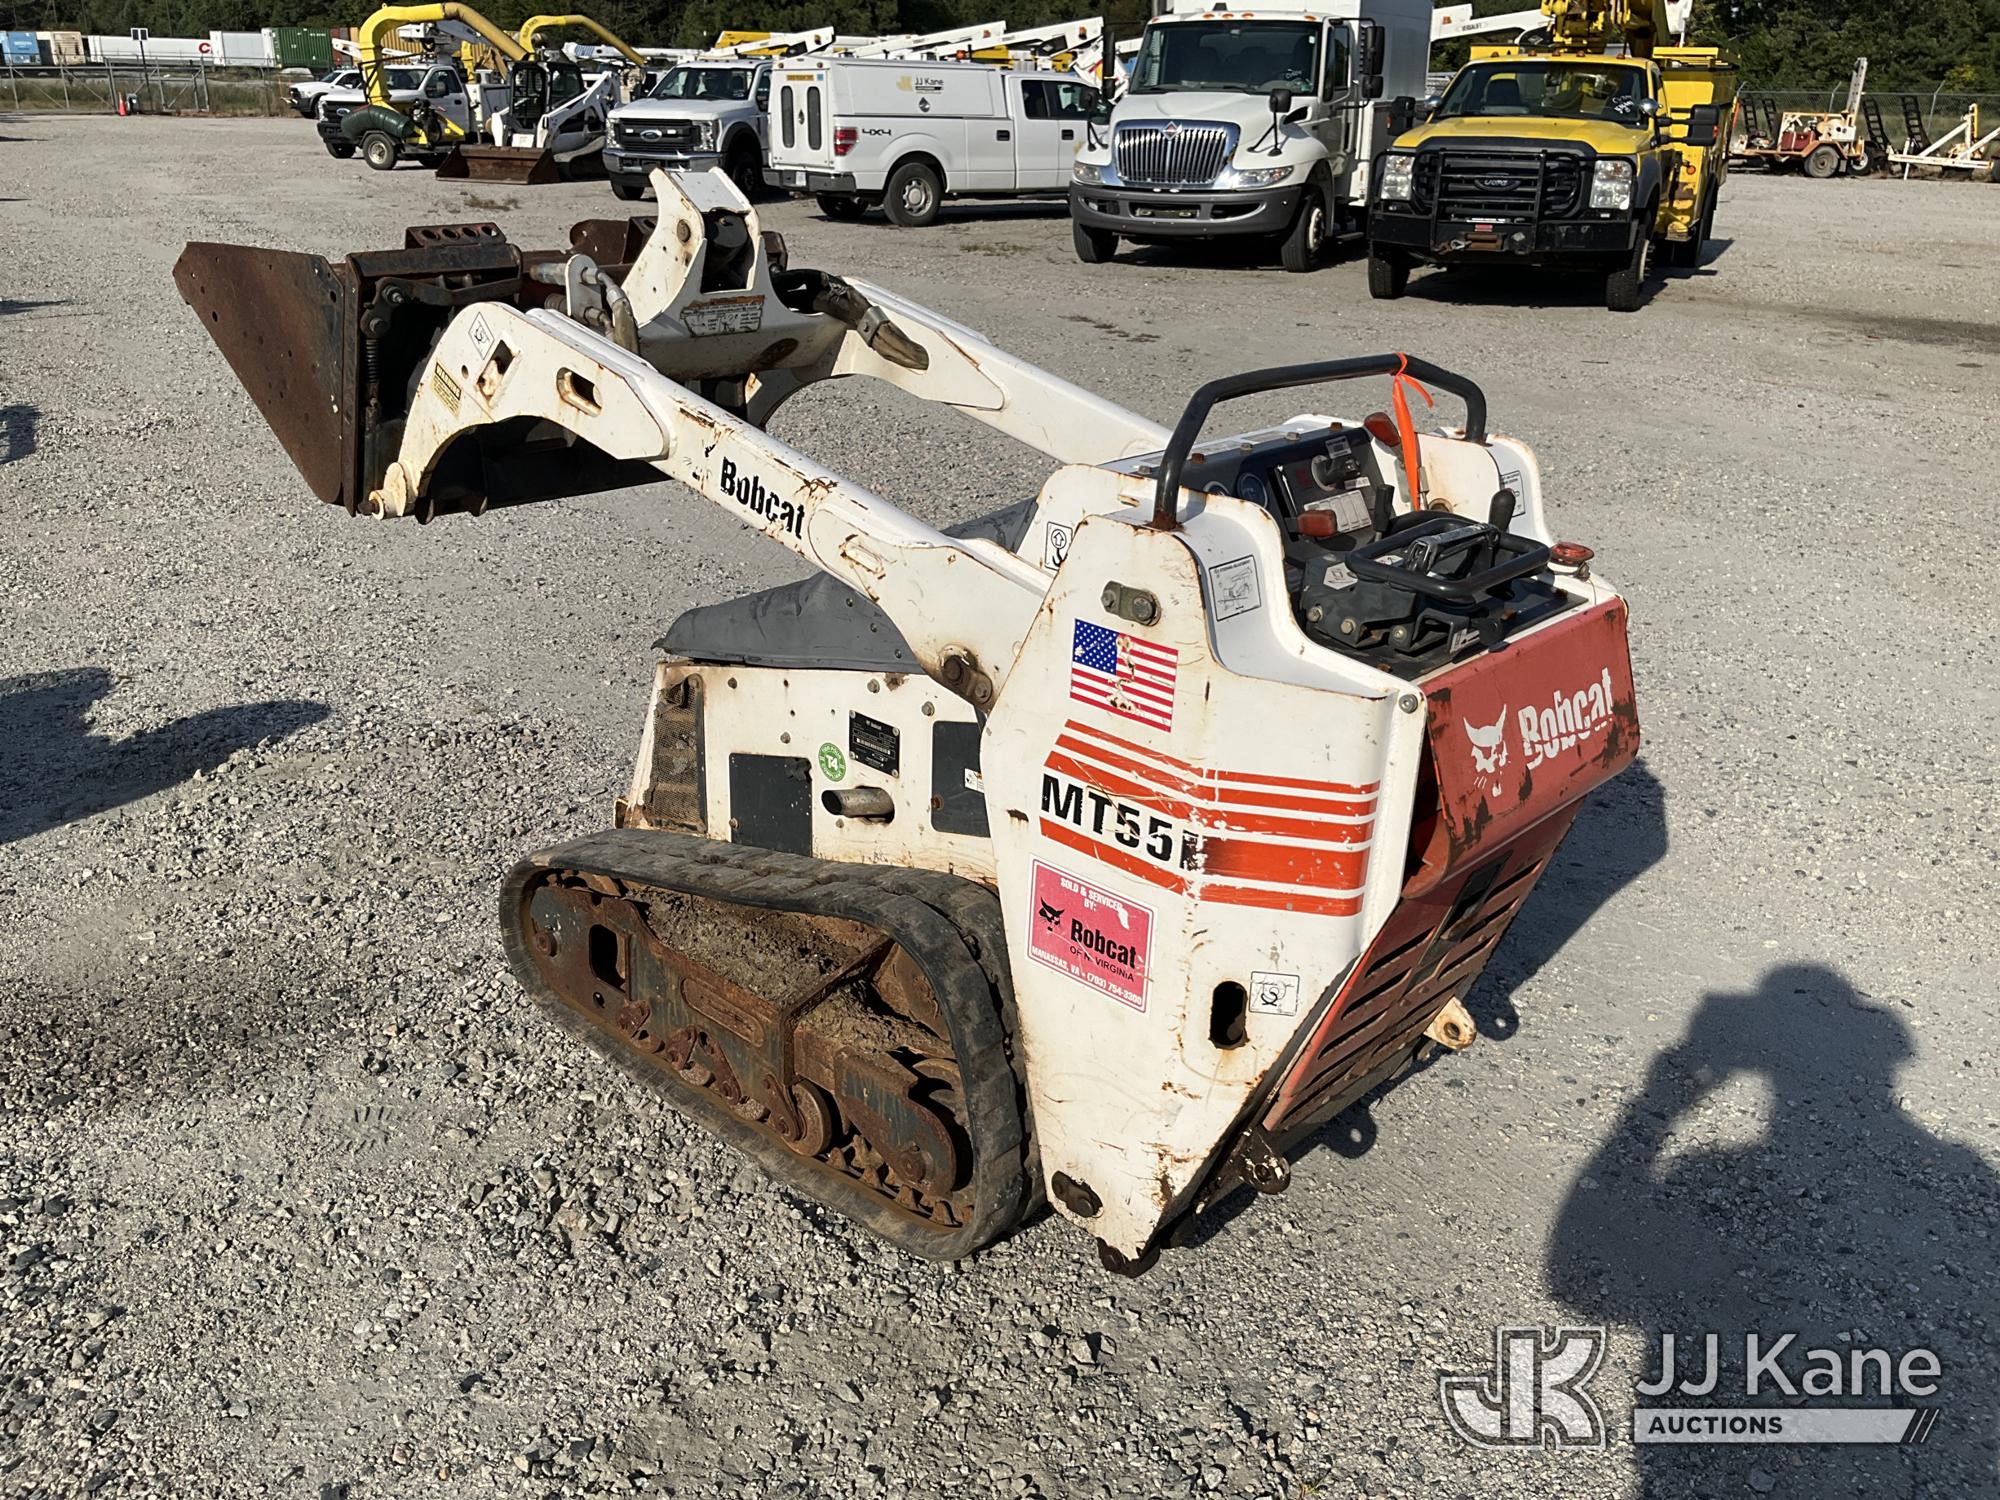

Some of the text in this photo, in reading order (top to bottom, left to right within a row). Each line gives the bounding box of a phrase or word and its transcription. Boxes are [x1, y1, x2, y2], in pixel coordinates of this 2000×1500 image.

[720, 456, 805, 540] Bobcat
[1518, 667, 1614, 770] Bobcat
[826, 755, 839, 771] T4
[1060, 877, 1079, 893] SOLD
[1080, 885, 1087, 897] &
[1084, 898, 1097, 911] BY:
[1071, 918, 1137, 969] Bobcat
[1070, 963, 1080, 976] VA
[1095, 957, 1135, 982] VIRGINIA
